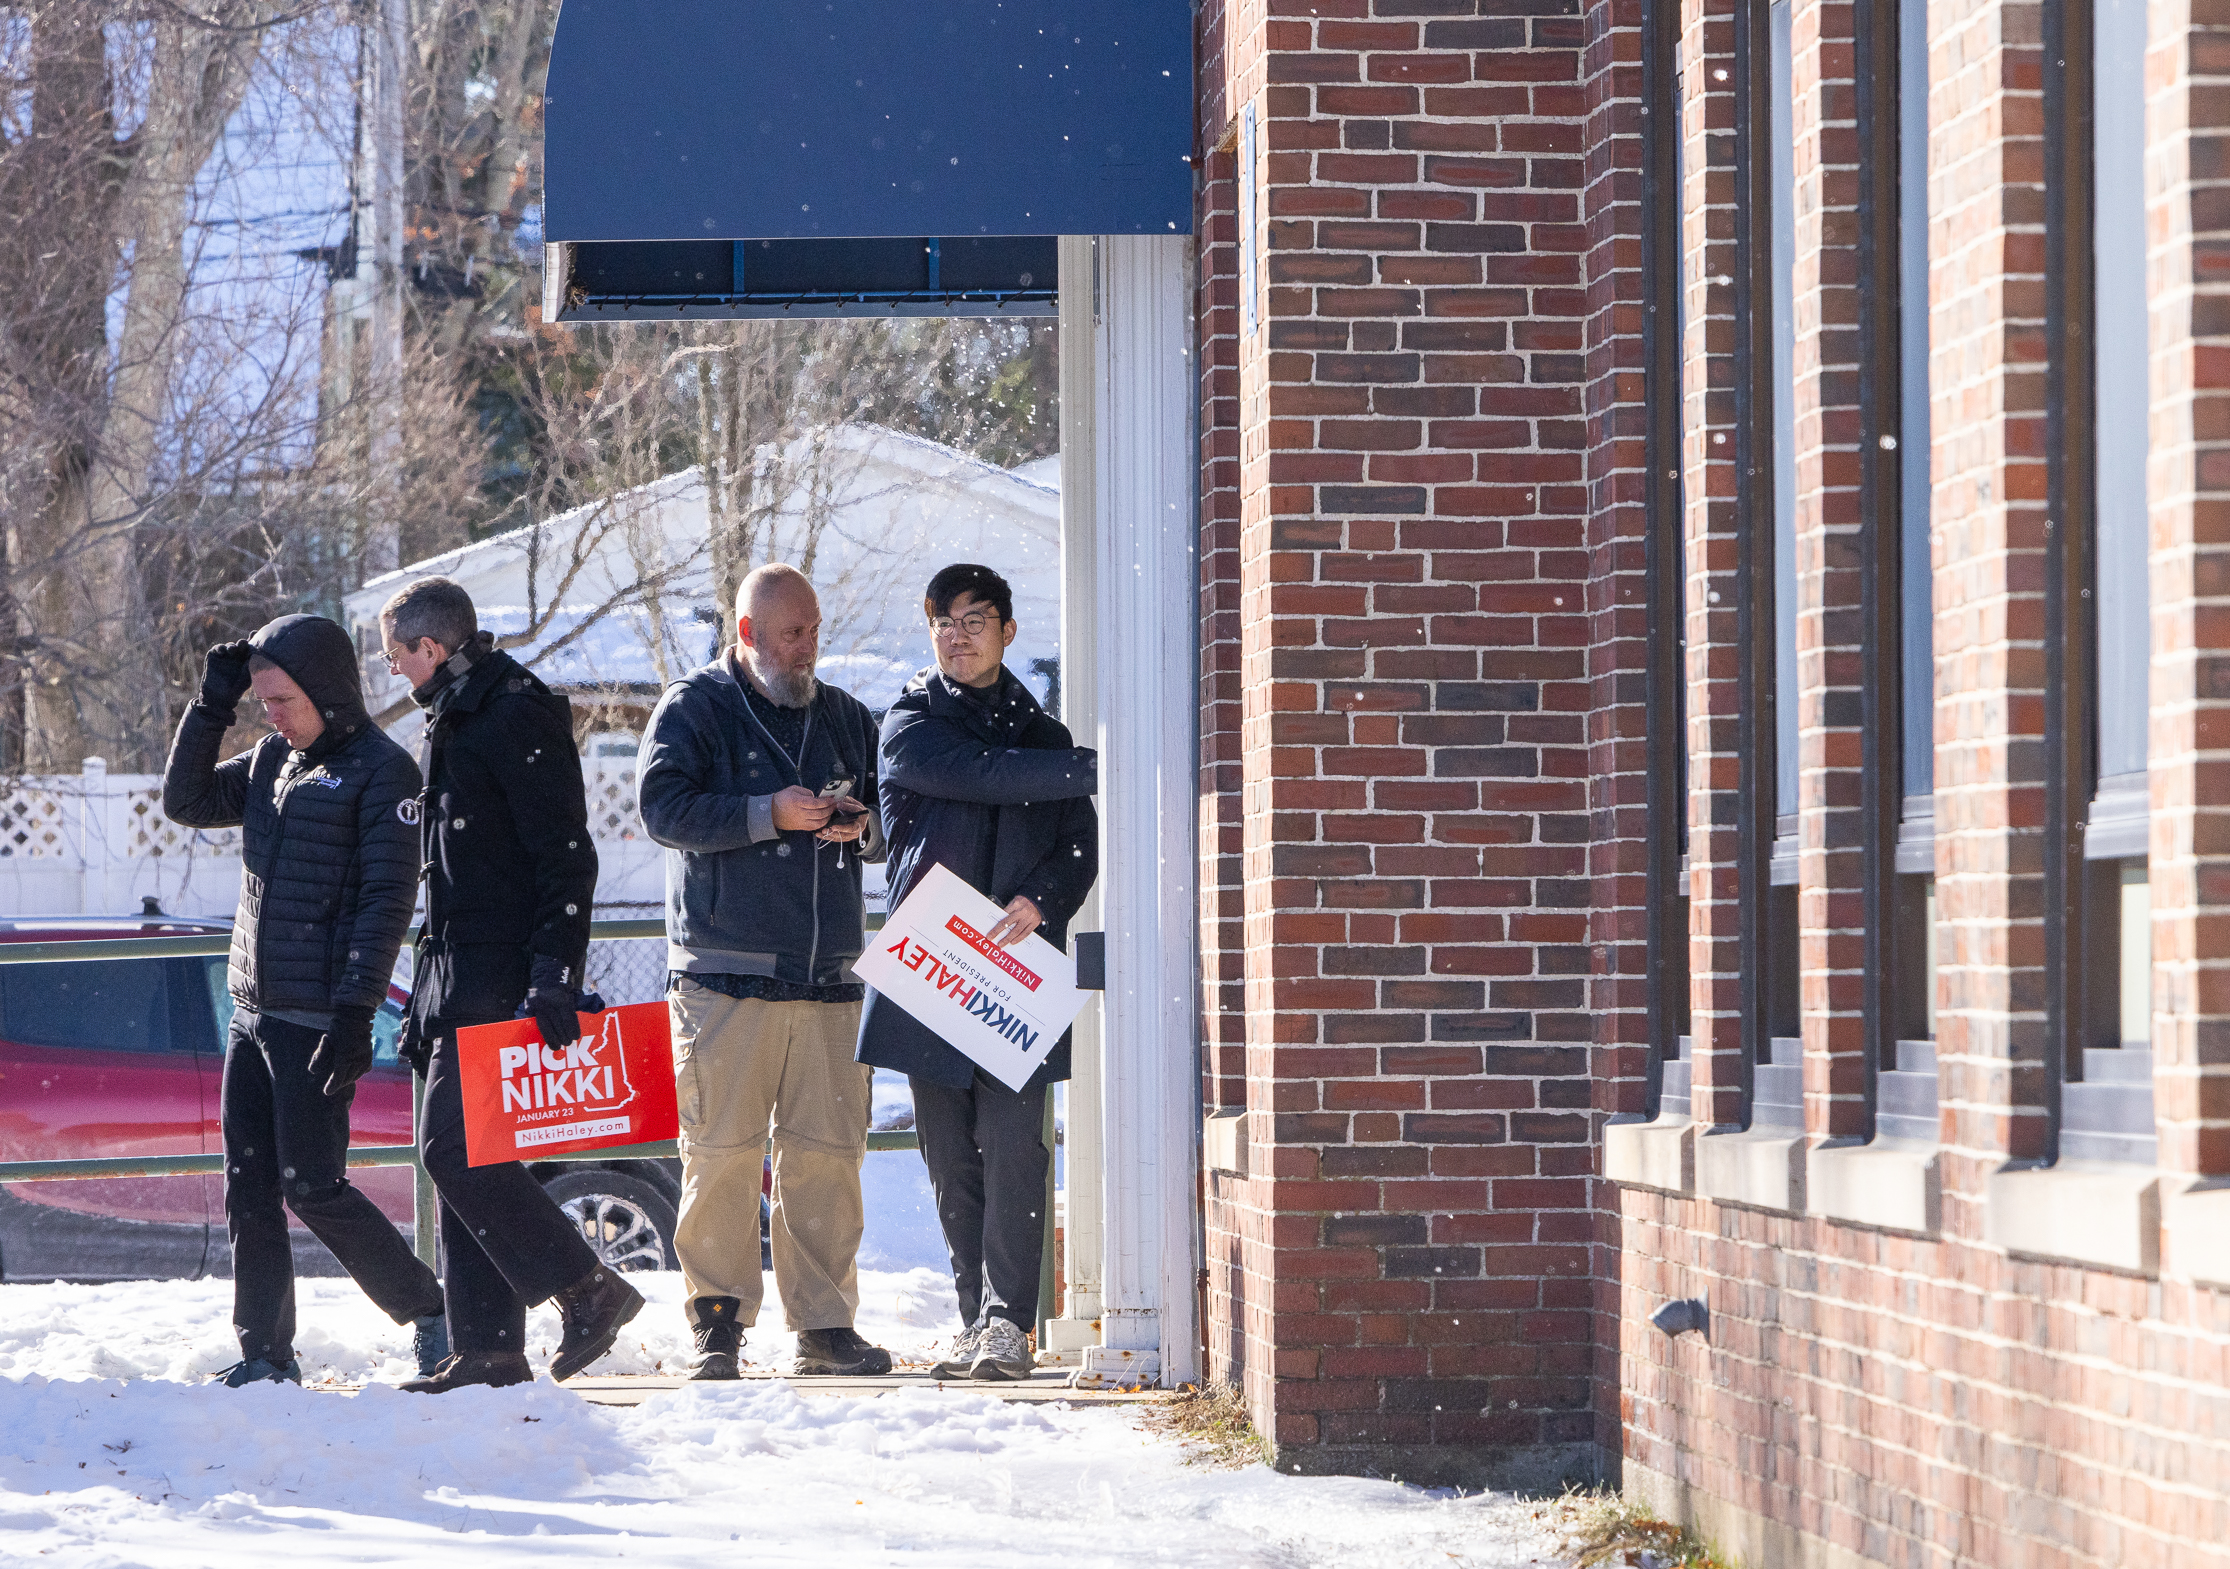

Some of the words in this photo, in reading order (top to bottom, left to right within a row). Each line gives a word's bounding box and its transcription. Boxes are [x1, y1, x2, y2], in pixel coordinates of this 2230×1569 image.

[943, 949, 991, 986] PRESIDENT
[952, 920, 1034, 987] NikkiHaley.com
[992, 983, 1011, 1002] FOR
[499, 1035, 598, 1078] PICK
[502, 1065, 615, 1113] NIKKI
[516, 1110, 560, 1124] JANUARY
[562, 1107, 574, 1117] 23
[522, 1122, 624, 1142] NikkiHaley.com
